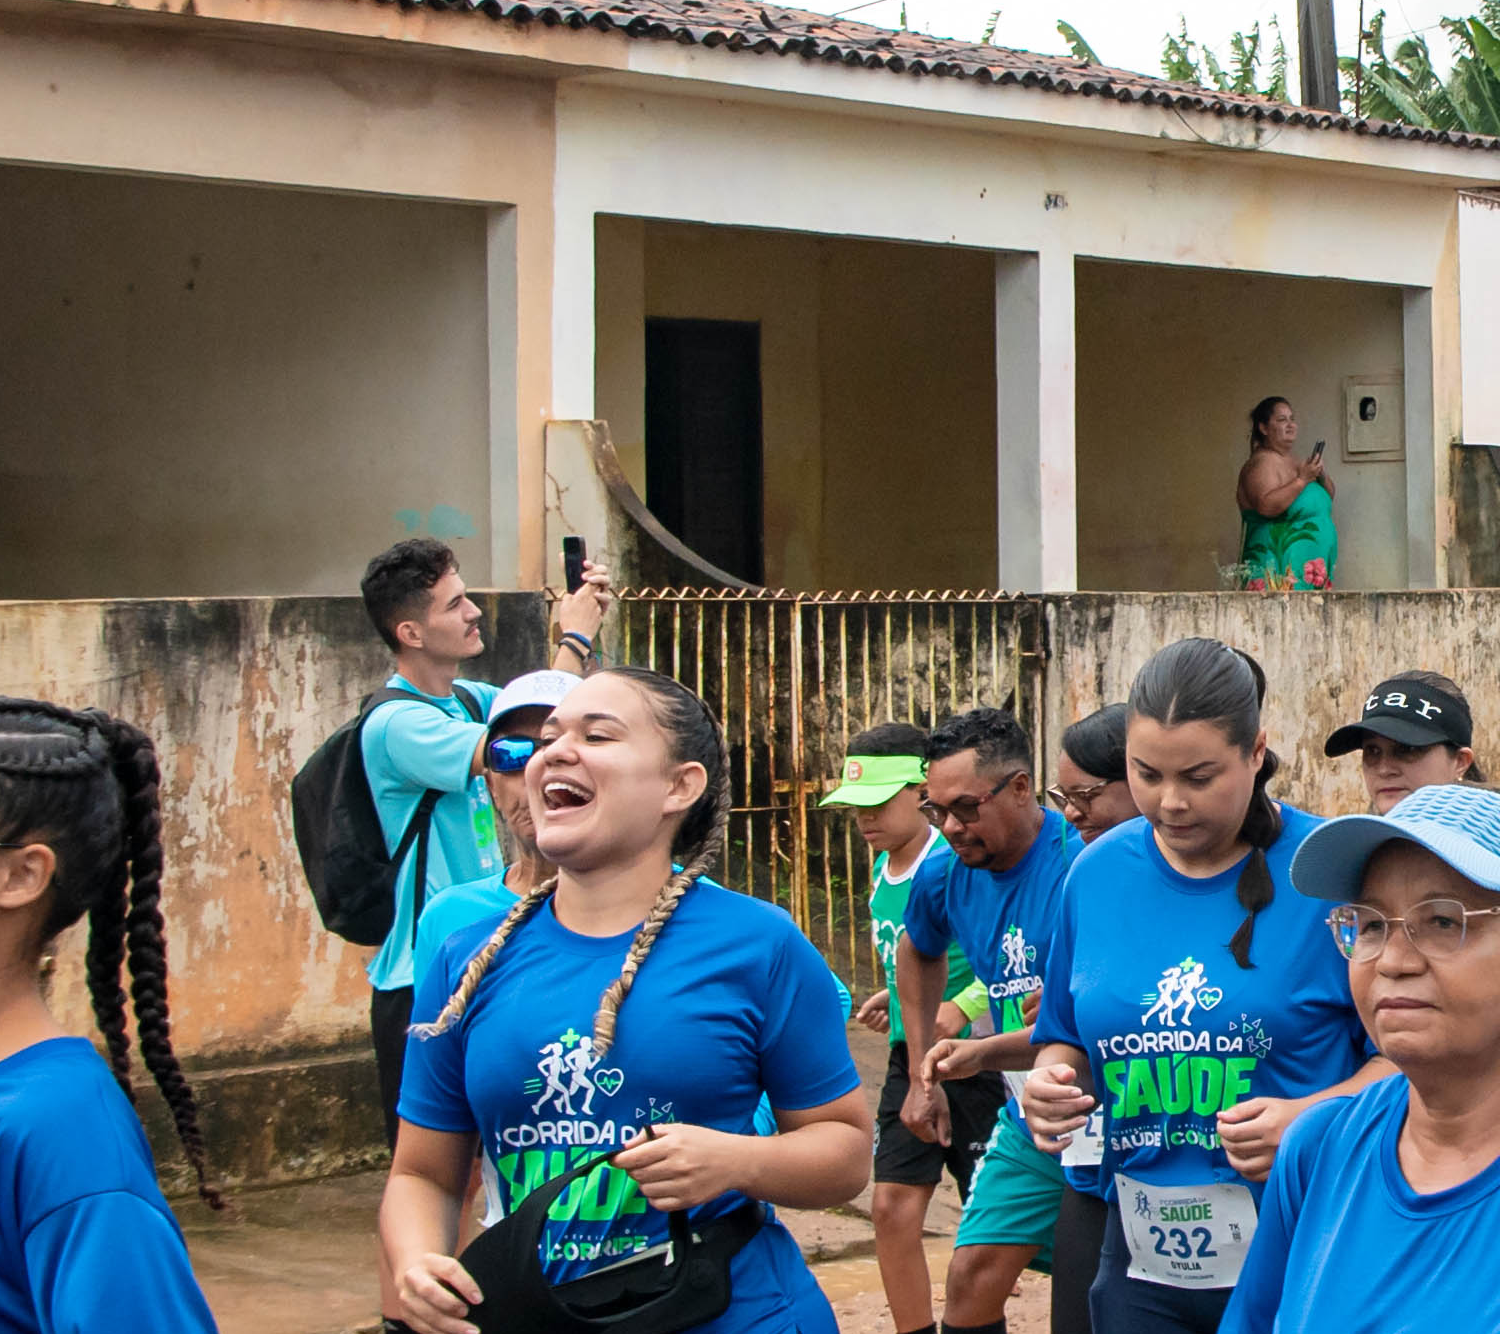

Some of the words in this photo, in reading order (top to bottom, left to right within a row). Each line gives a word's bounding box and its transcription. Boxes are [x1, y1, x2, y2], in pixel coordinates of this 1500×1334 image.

[1110, 1030, 1211, 1056] CORRIDA
[1216, 1037, 1243, 1052] DA
[1103, 1053, 1258, 1119] SAÚDE
[503, 1120, 616, 1147] CORRIDA
[1111, 1130, 1162, 1152] SAÚDE
[1149, 1225, 1218, 1260] 232
